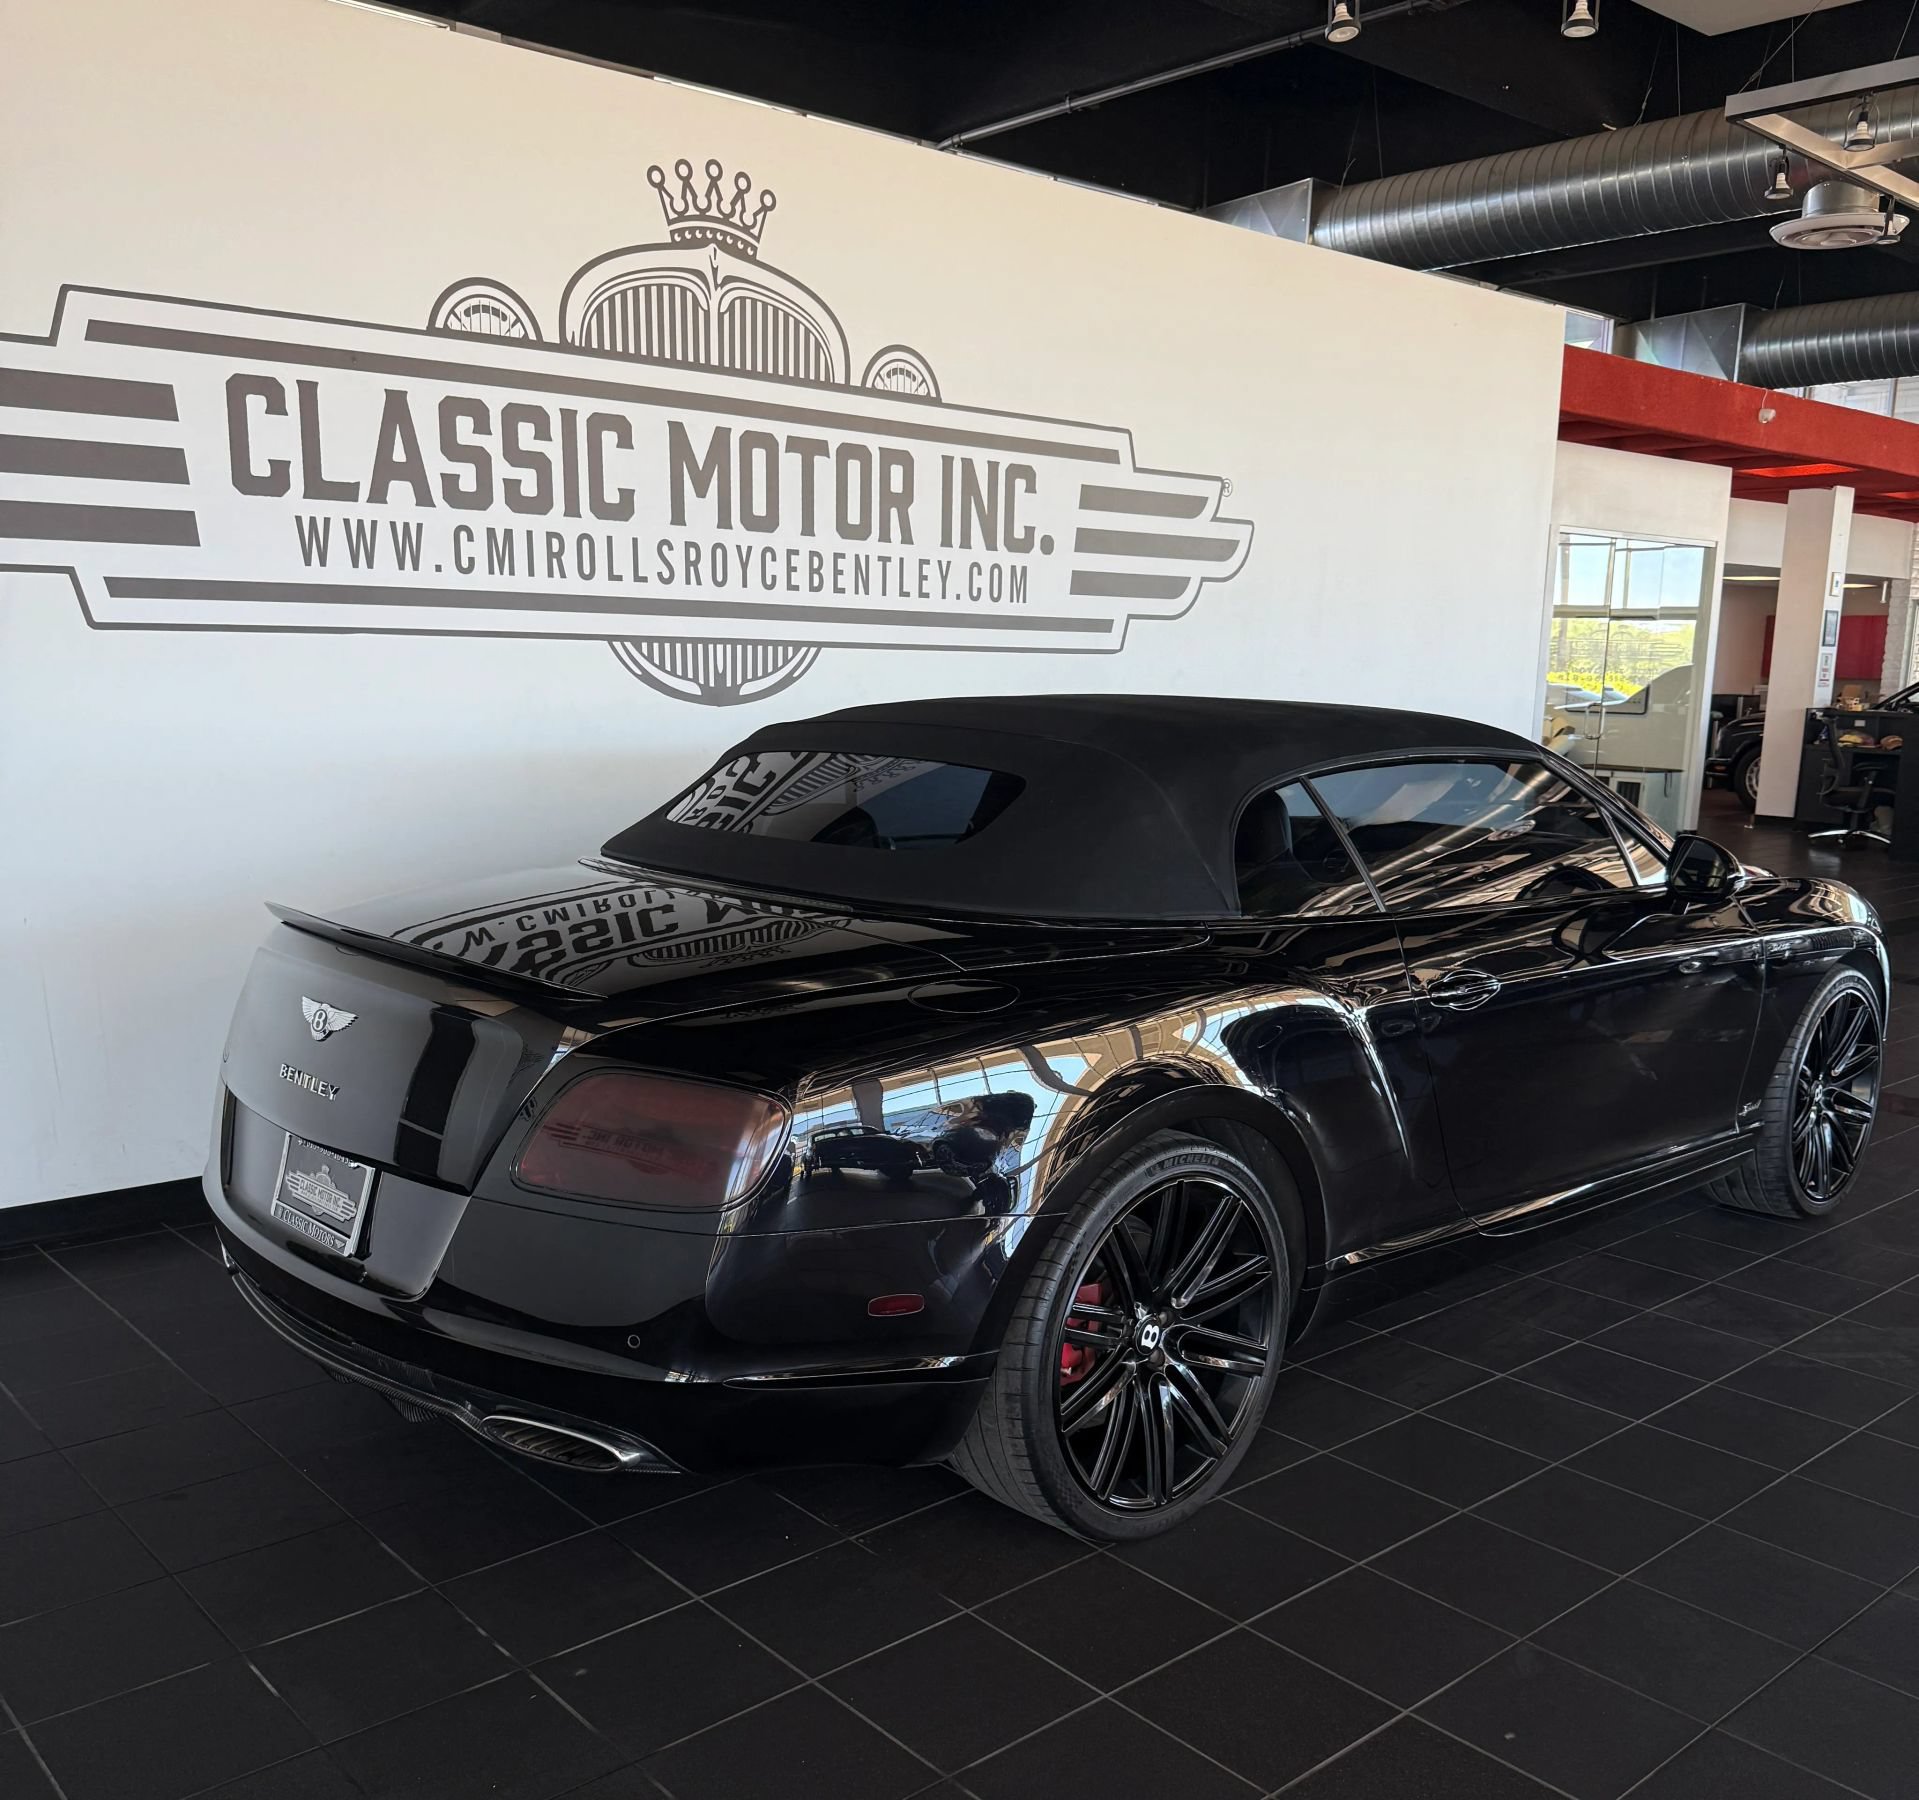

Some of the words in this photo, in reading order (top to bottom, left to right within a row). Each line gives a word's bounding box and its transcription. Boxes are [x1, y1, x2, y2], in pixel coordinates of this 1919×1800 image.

[225, 372, 637, 523] CLASSIC
[667, 420, 916, 546] MOTOR
[940, 454, 1055, 556] INC.
[295, 514, 1029, 604] WWW.CMIROLLSROYCEBENTLEY.COM
[280, 1063, 340, 1100] BENTLEY
[1164, 1153, 1219, 1169] MICHELIN
[283, 1209, 309, 1232] CLASSIC
[308, 1222, 336, 1247] MOTORS
[1141, 1324, 1160, 1350] B
